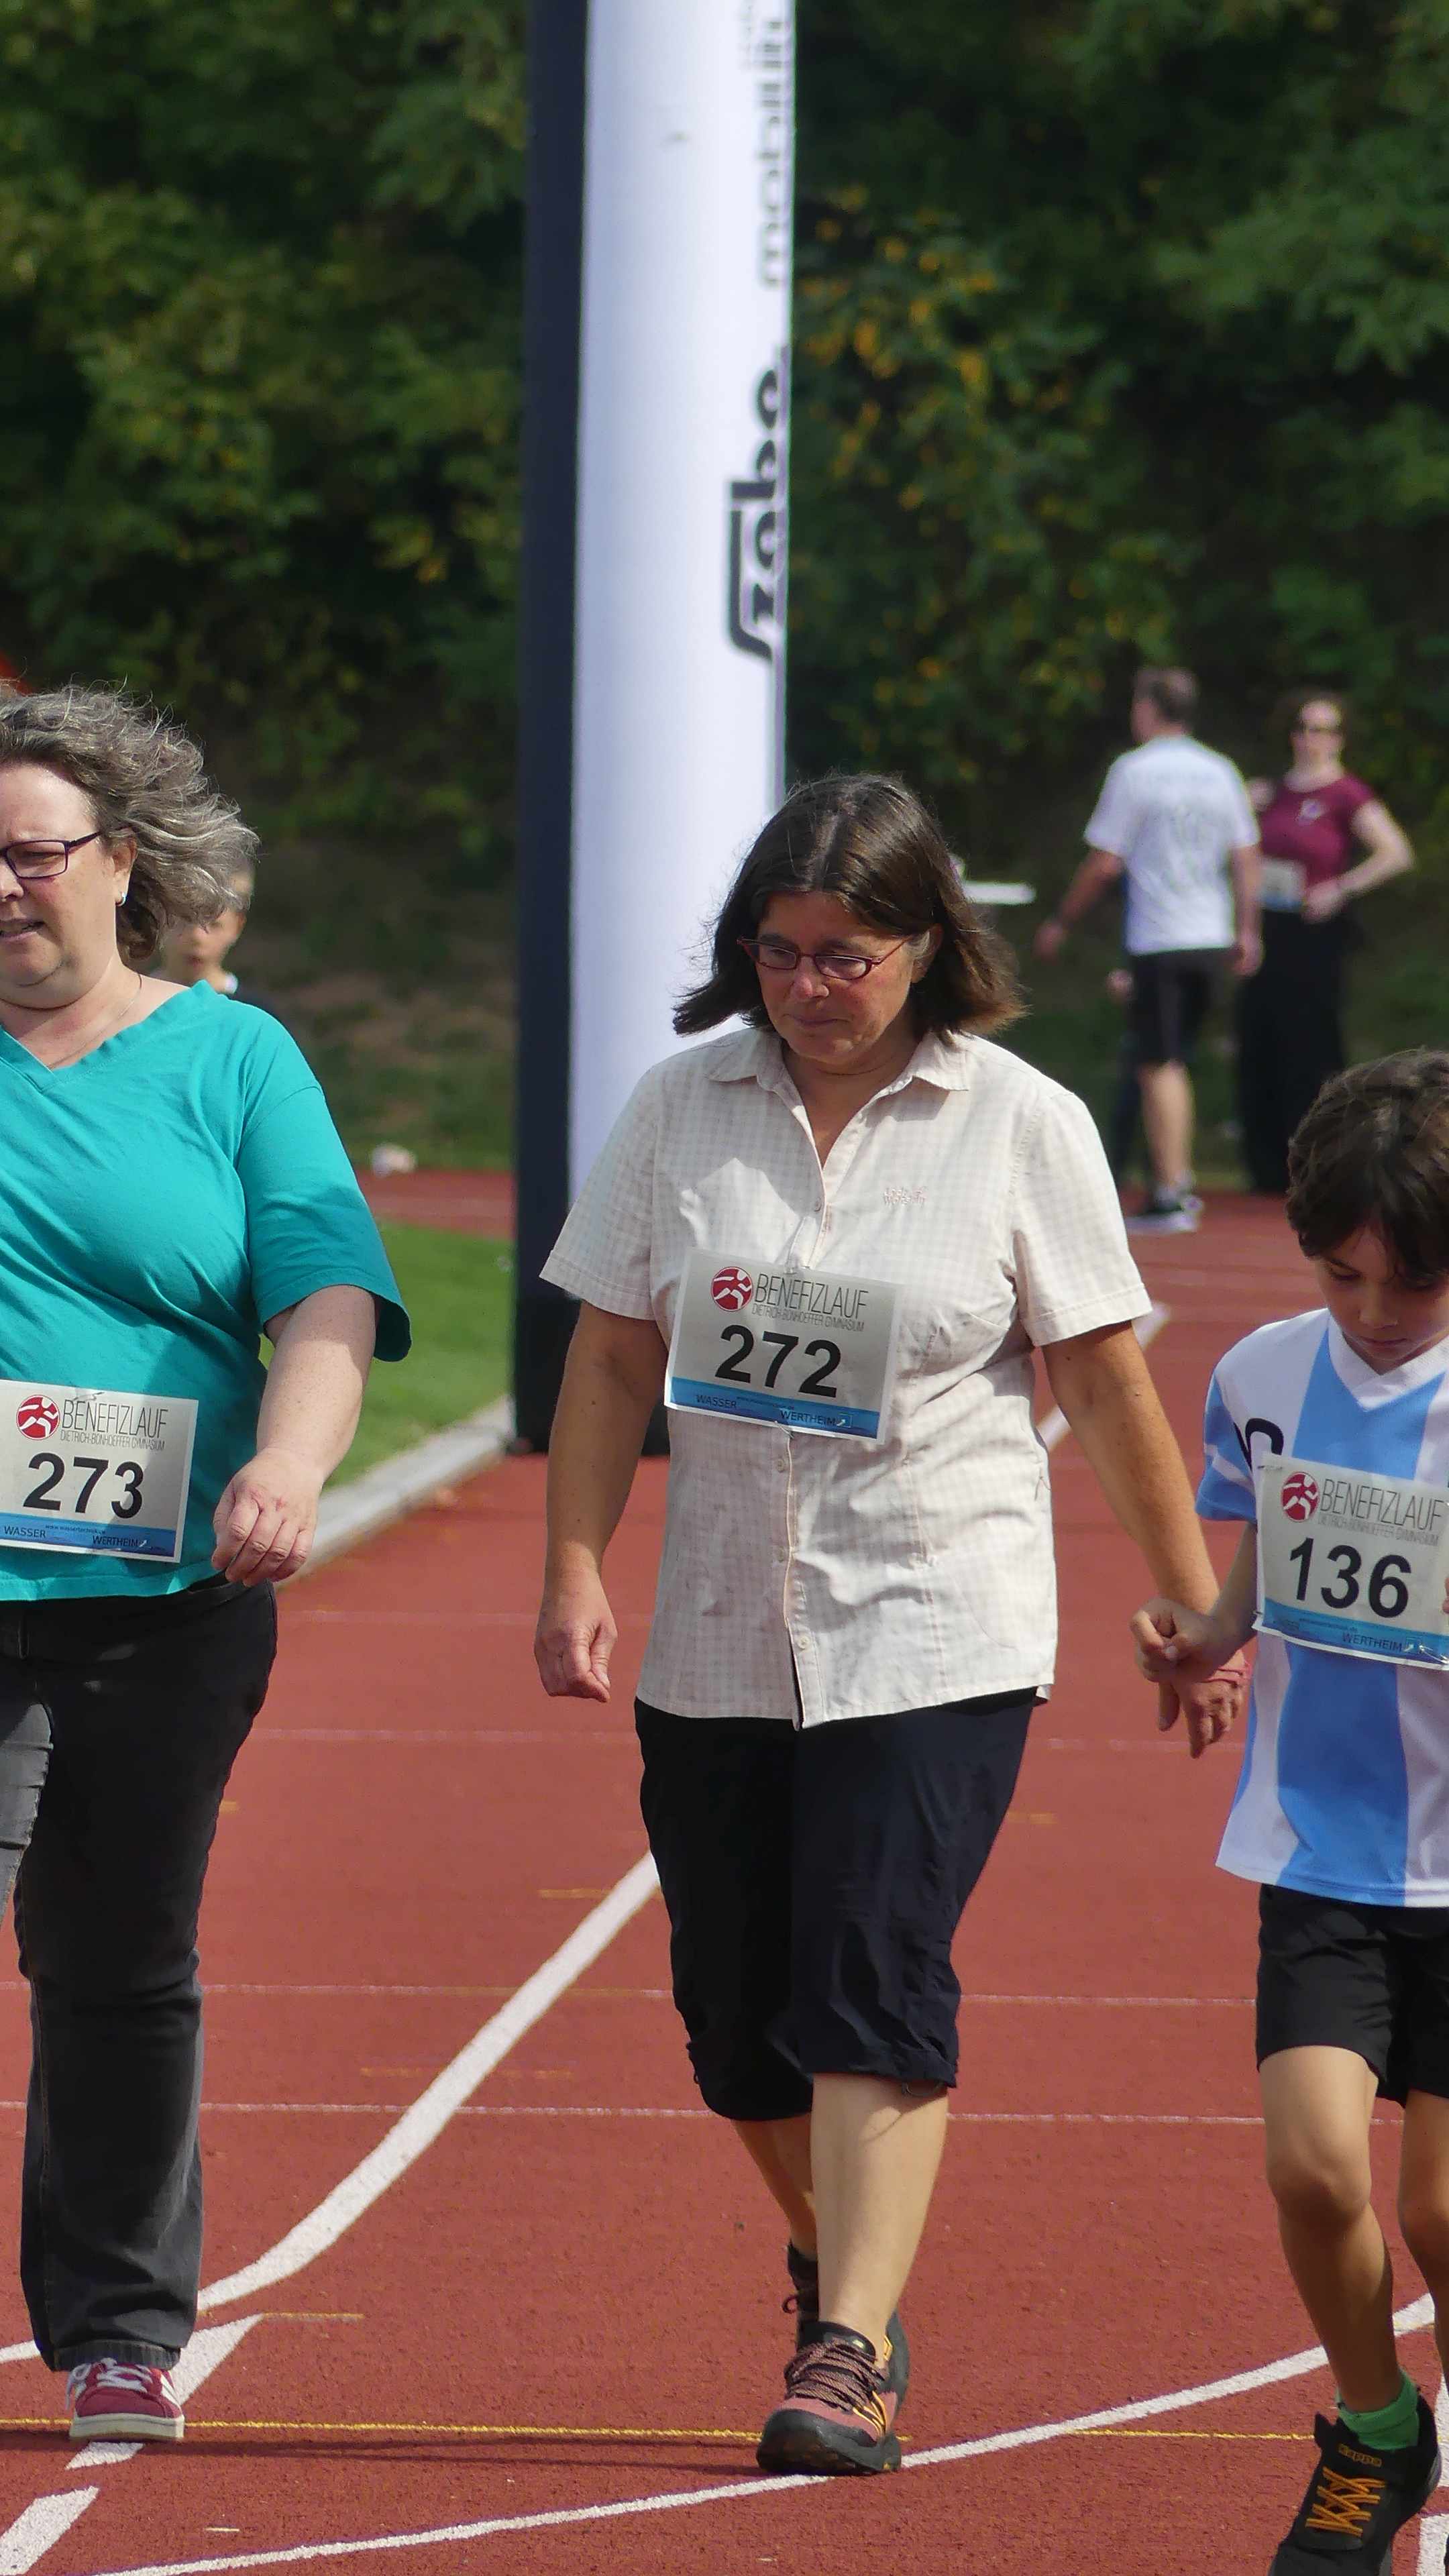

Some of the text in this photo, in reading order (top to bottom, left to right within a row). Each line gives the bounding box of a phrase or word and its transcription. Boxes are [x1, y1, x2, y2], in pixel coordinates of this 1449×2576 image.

[755, 1273, 869, 1320] BENEFIZLAUF
[714, 1325, 841, 1398] 272
[62, 1399, 168, 1439] BENEFIZLAUF
[695, 1394, 737, 1409] WASSER
[779, 1410, 837, 1428] WERTHEIM
[23, 1452, 144, 1519] 273
[1320, 1479, 1445, 1532] BENEFIZLAUF
[3, 1525, 46, 1538] WASSER
[1289, 1537, 1412, 1619] 136
[1342, 1631, 1403, 1652] WERTHEIM
